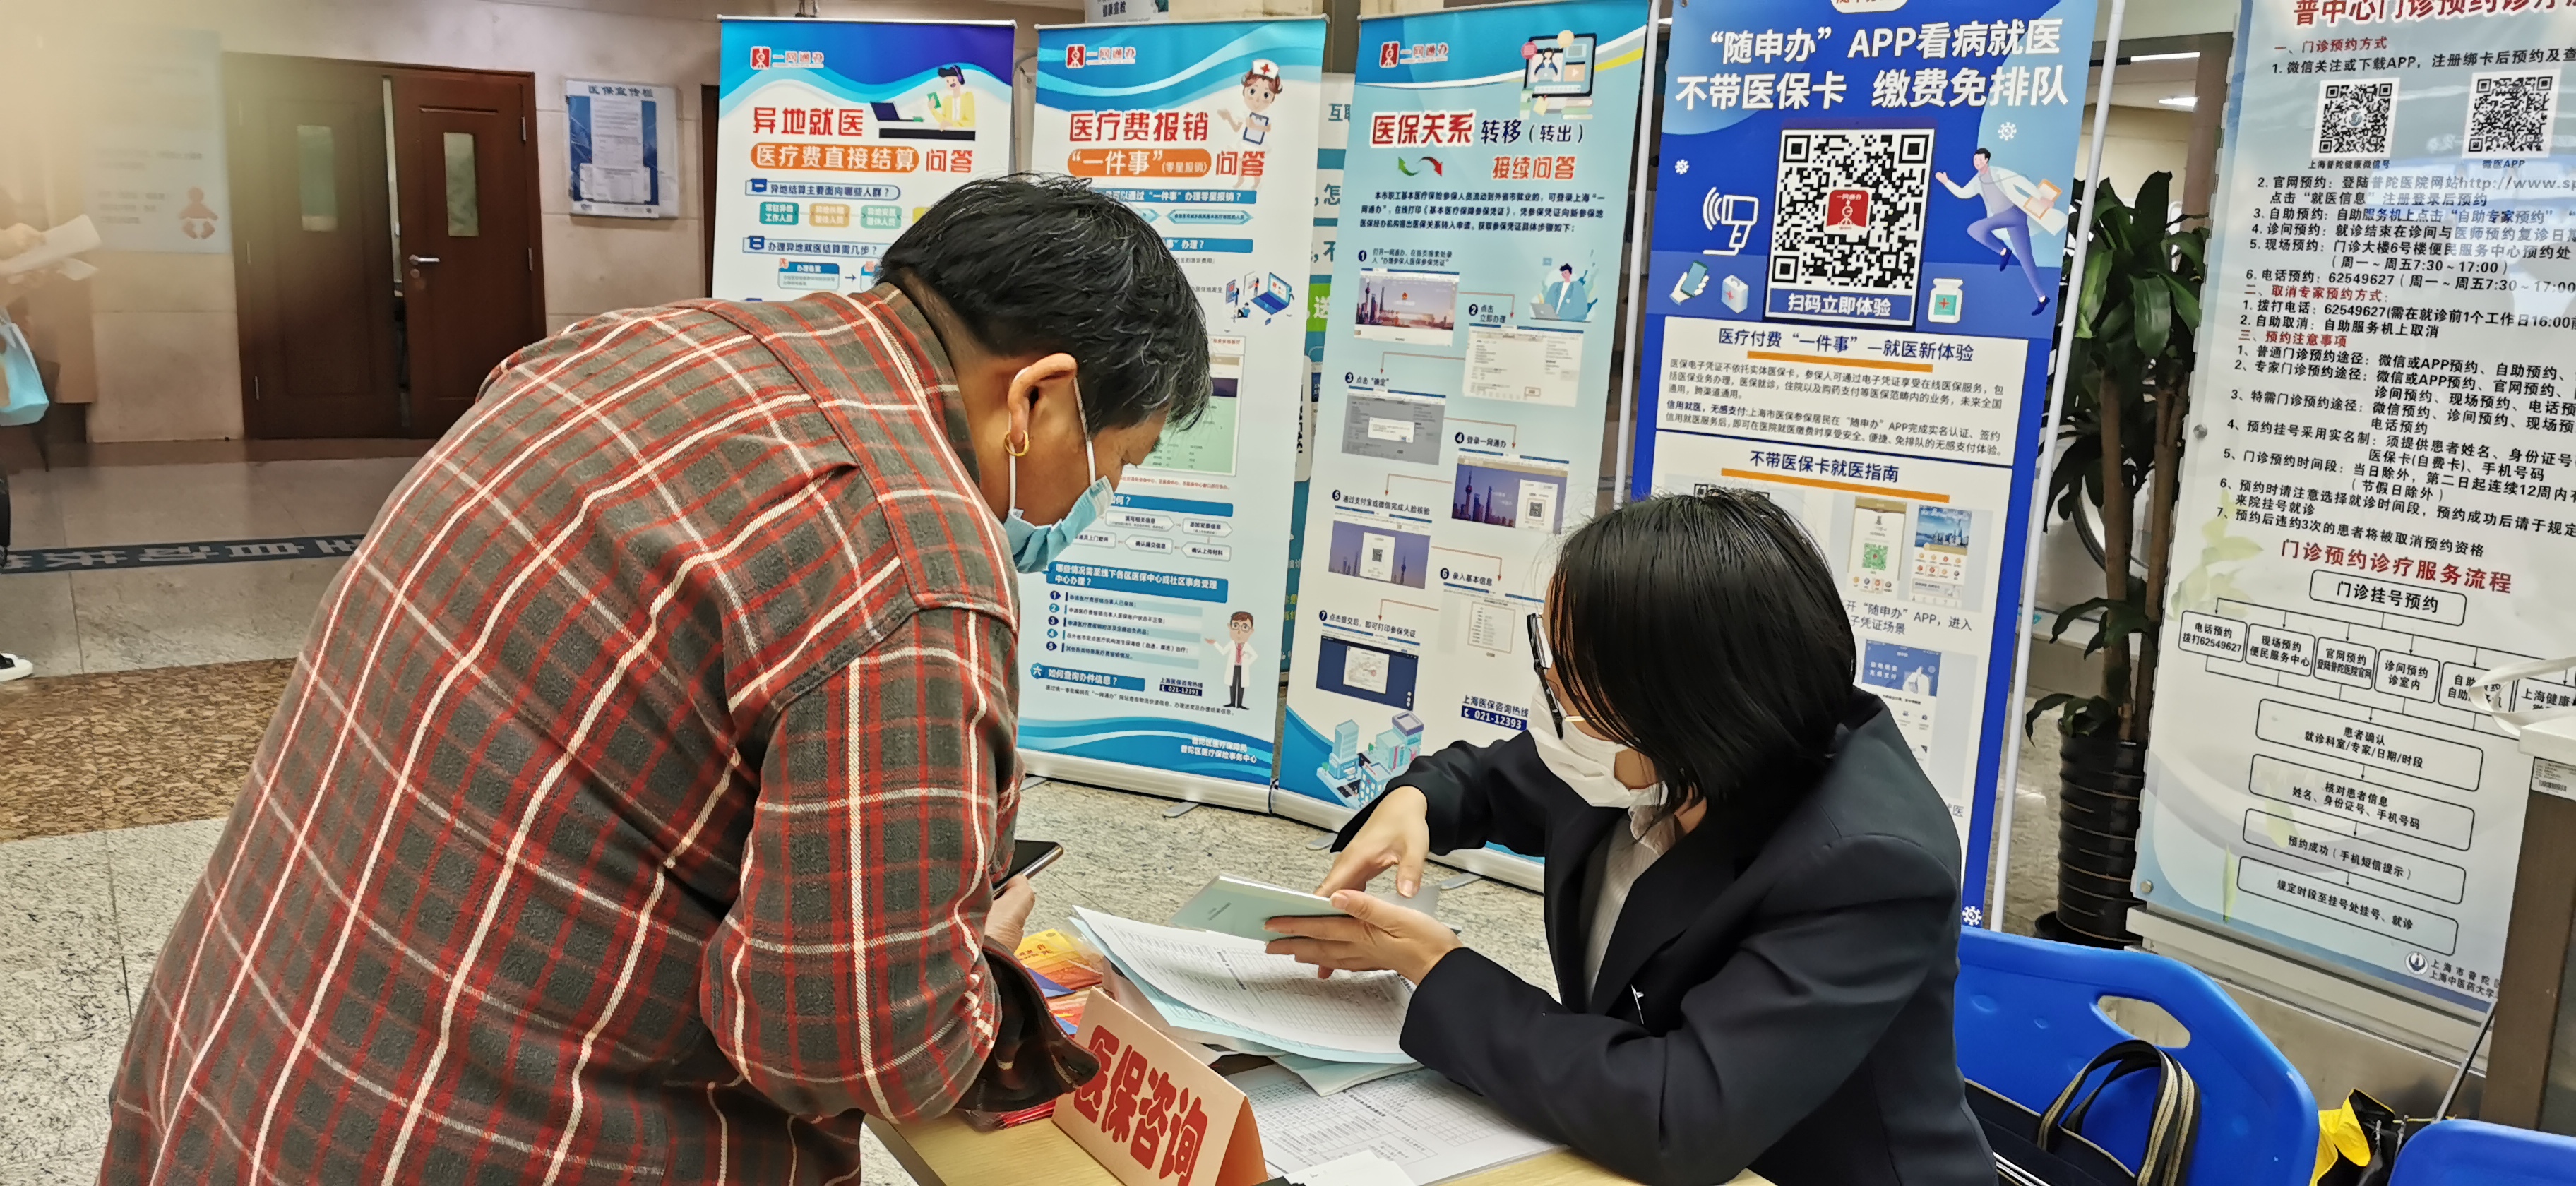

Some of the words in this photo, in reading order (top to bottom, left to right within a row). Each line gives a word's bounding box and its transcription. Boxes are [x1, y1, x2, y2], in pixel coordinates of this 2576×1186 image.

[1400, 42, 1448, 57] 一网通办
[1710, 26, 1832, 64] “随申办”
[1848, 18, 2063, 59] APP看病就医
[1675, 72, 1847, 111] 不带医保卡
[1872, 65, 2070, 109] 缴费免排队
[753, 107, 864, 137] 异地就医
[1069, 111, 1209, 142] 医疗费报销
[1373, 112, 1474, 145] 医保关系
[757, 145, 916, 171] 医疗费直接结算
[926, 149, 973, 173] 问答
[1216, 150, 1265, 176] 问答
[1492, 155, 1576, 180] 接续问答
[2308, 159, 2391, 170] 上海普陀健康微信号
[2482, 158, 2526, 169] 微医APP
[770, 184, 890, 198] 异地结算主要面向哪些人群？
[768, 242, 878, 255] 办理异地就医结算需几步？
[1788, 293, 1892, 318] 扫码立即体验
[2371, 418, 2428, 436] 电话预约
[1467, 435, 1507, 448] 登录一网通办
[1750, 450, 1900, 483] 不带医保卡就医指南
[2235, 494, 2315, 516] 来院挂号就诊
[2282, 539, 2512, 594] 门诊预约诊疗服务流程
[1453, 573, 1493, 587] 录入基本信息
[2337, 580, 2440, 613] 门诊挂号预约
[2194, 621, 2233, 639] 电话预约
[2182, 632, 2242, 654] 拨打62549627
[2260, 635, 2302, 653] 现场预约
[2249, 645, 2310, 667] 便民服务中心
[2325, 647, 2368, 666] 官网预约
[1049, 668, 1118, 686] 如何查询办件信息？
[2385, 659, 2428, 678] 诊间预约
[2388, 674, 2421, 692] 诊室内
[1462, 694, 1530, 718] 上海医保咨询热线
[1474, 709, 1522, 730] 021-12393
[2343, 725, 2387, 747] 患者确认
[2305, 730, 2424, 770] 就诊科室/专家/日期/时段
[2325, 781, 2389, 808] 核对患者信息
[2292, 786, 2421, 831] 姓名、身份证号、手机号码
[2277, 878, 2414, 932] 规定时段至挂号处挂号、就诊
[1074, 1025, 1208, 1186] 医保咨询
